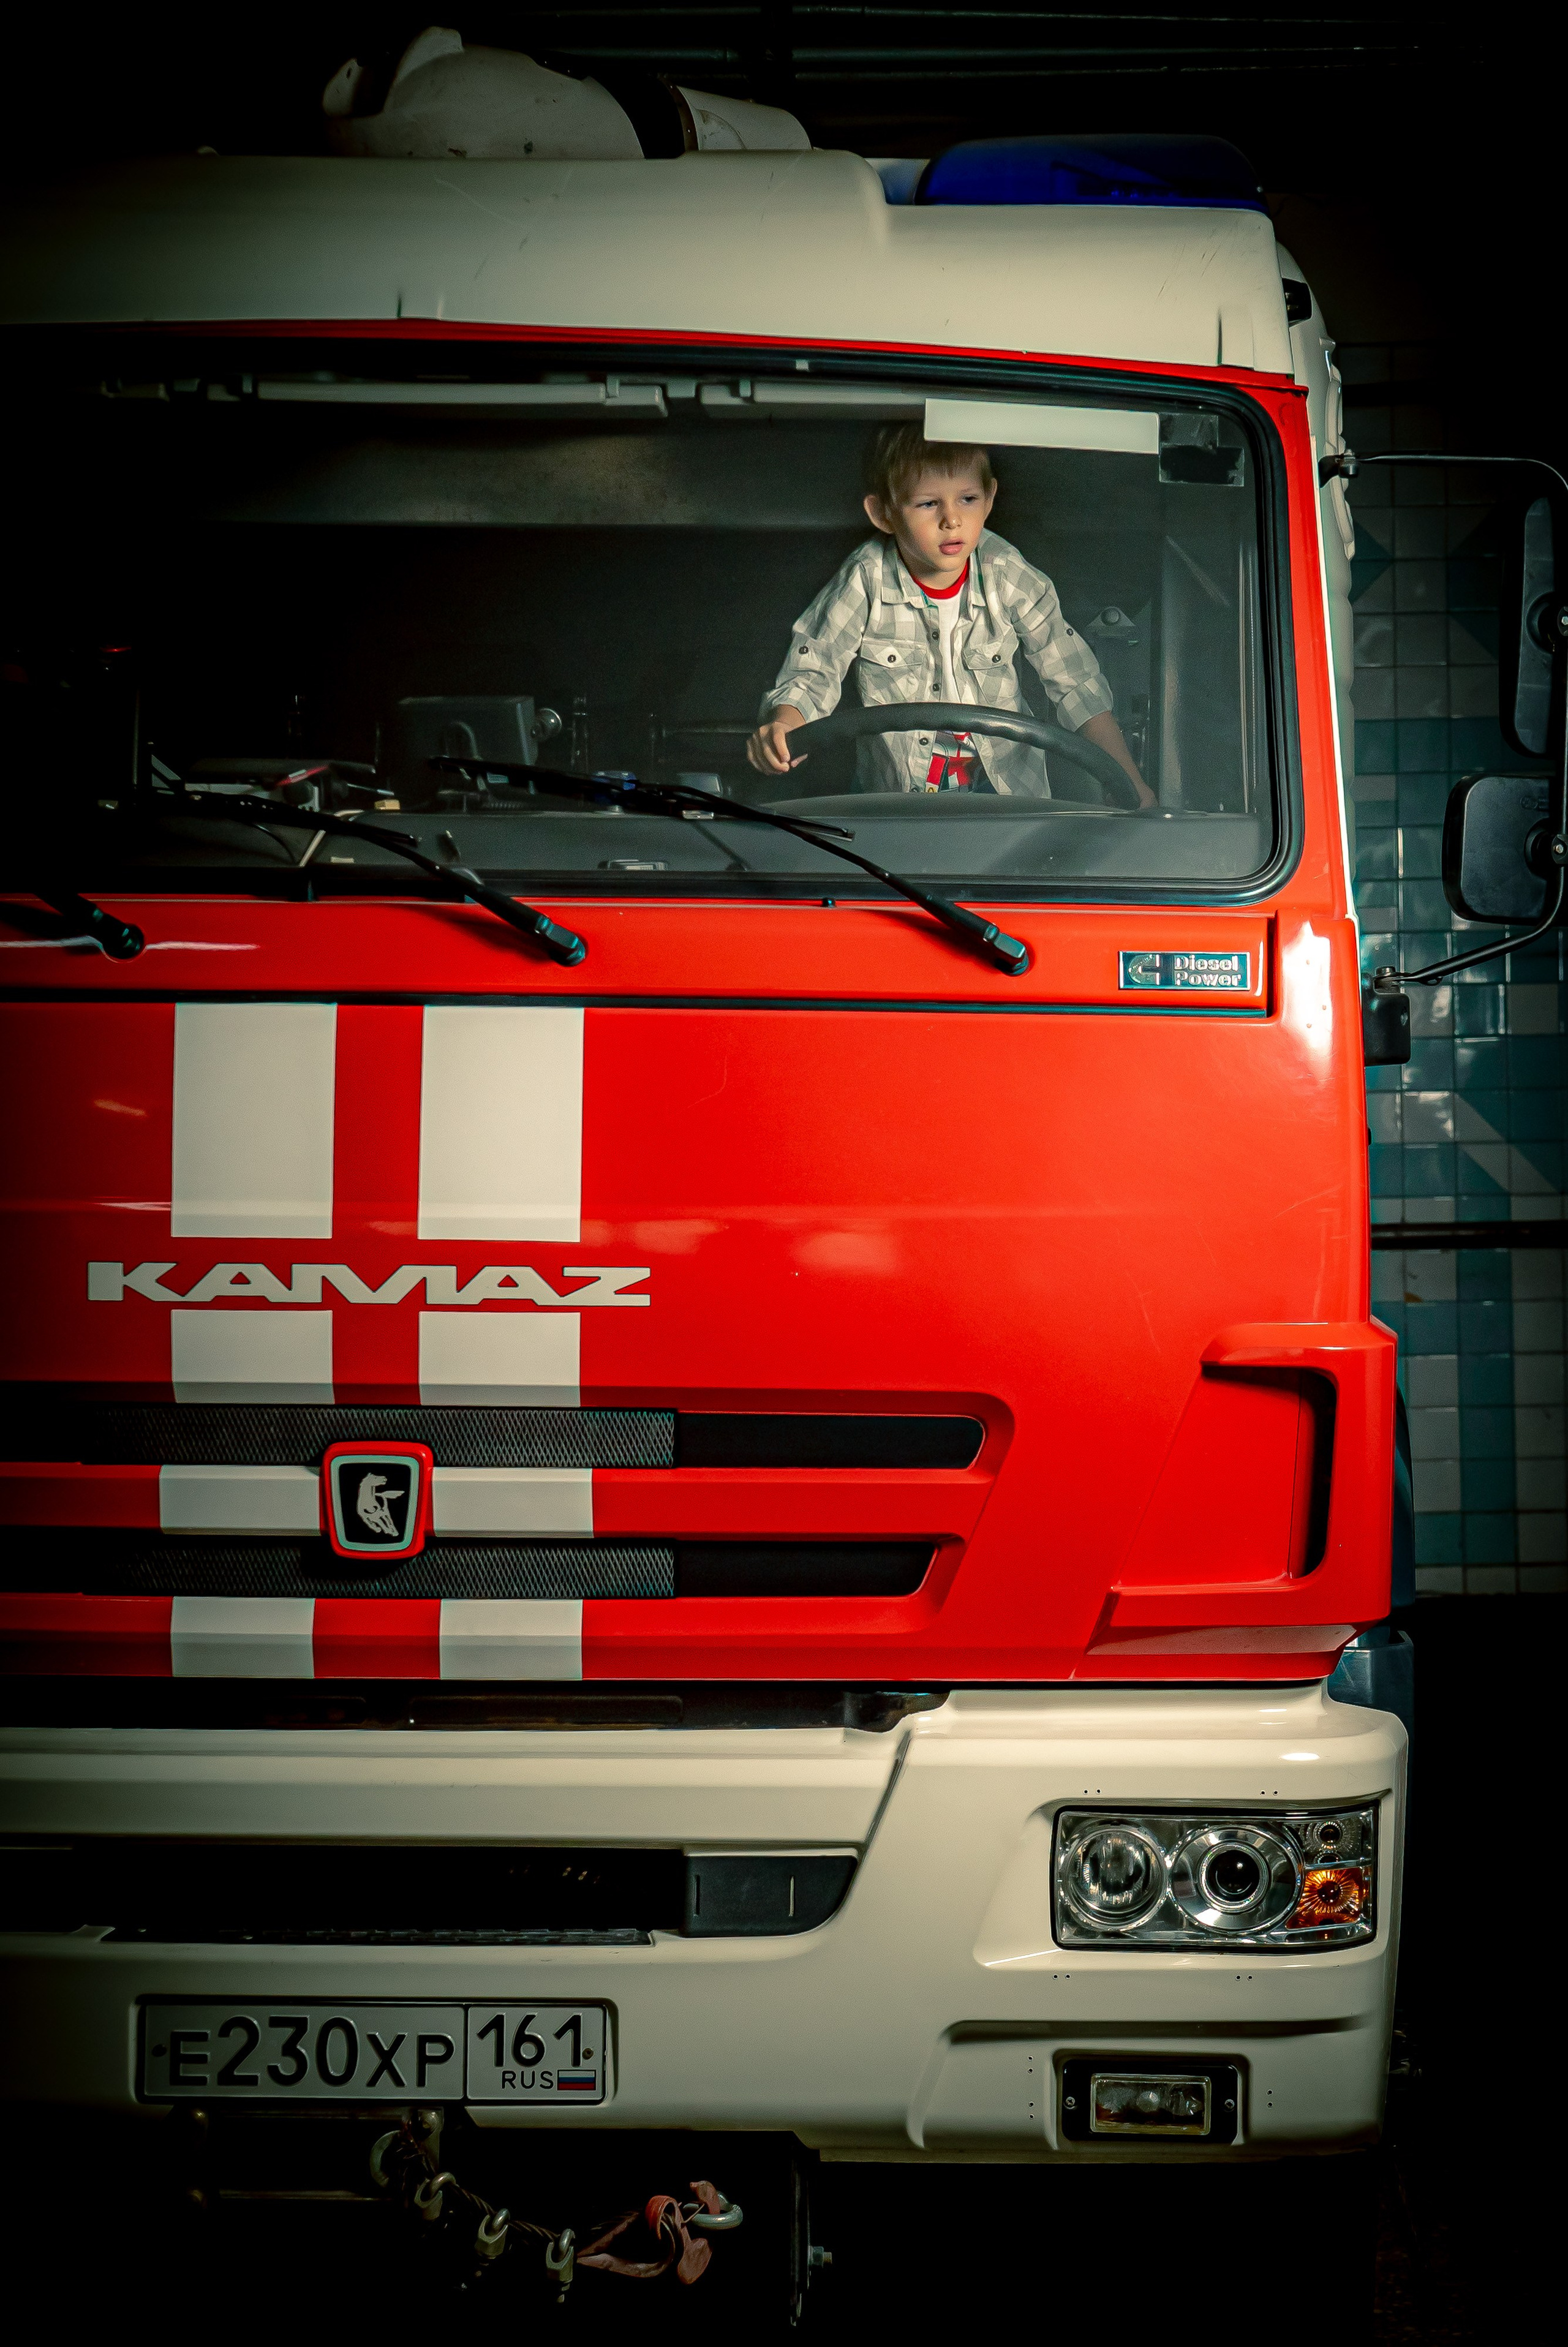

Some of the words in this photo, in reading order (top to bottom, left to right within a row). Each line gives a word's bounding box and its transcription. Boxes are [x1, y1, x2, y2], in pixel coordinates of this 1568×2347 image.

[1174, 955, 1238, 971] Diesel
[1174, 971, 1242, 987] Power
[88, 1262, 650, 1306] KAMAZ
[477, 2013, 584, 2068] 161
[500, 2070, 555, 2090] RUS
